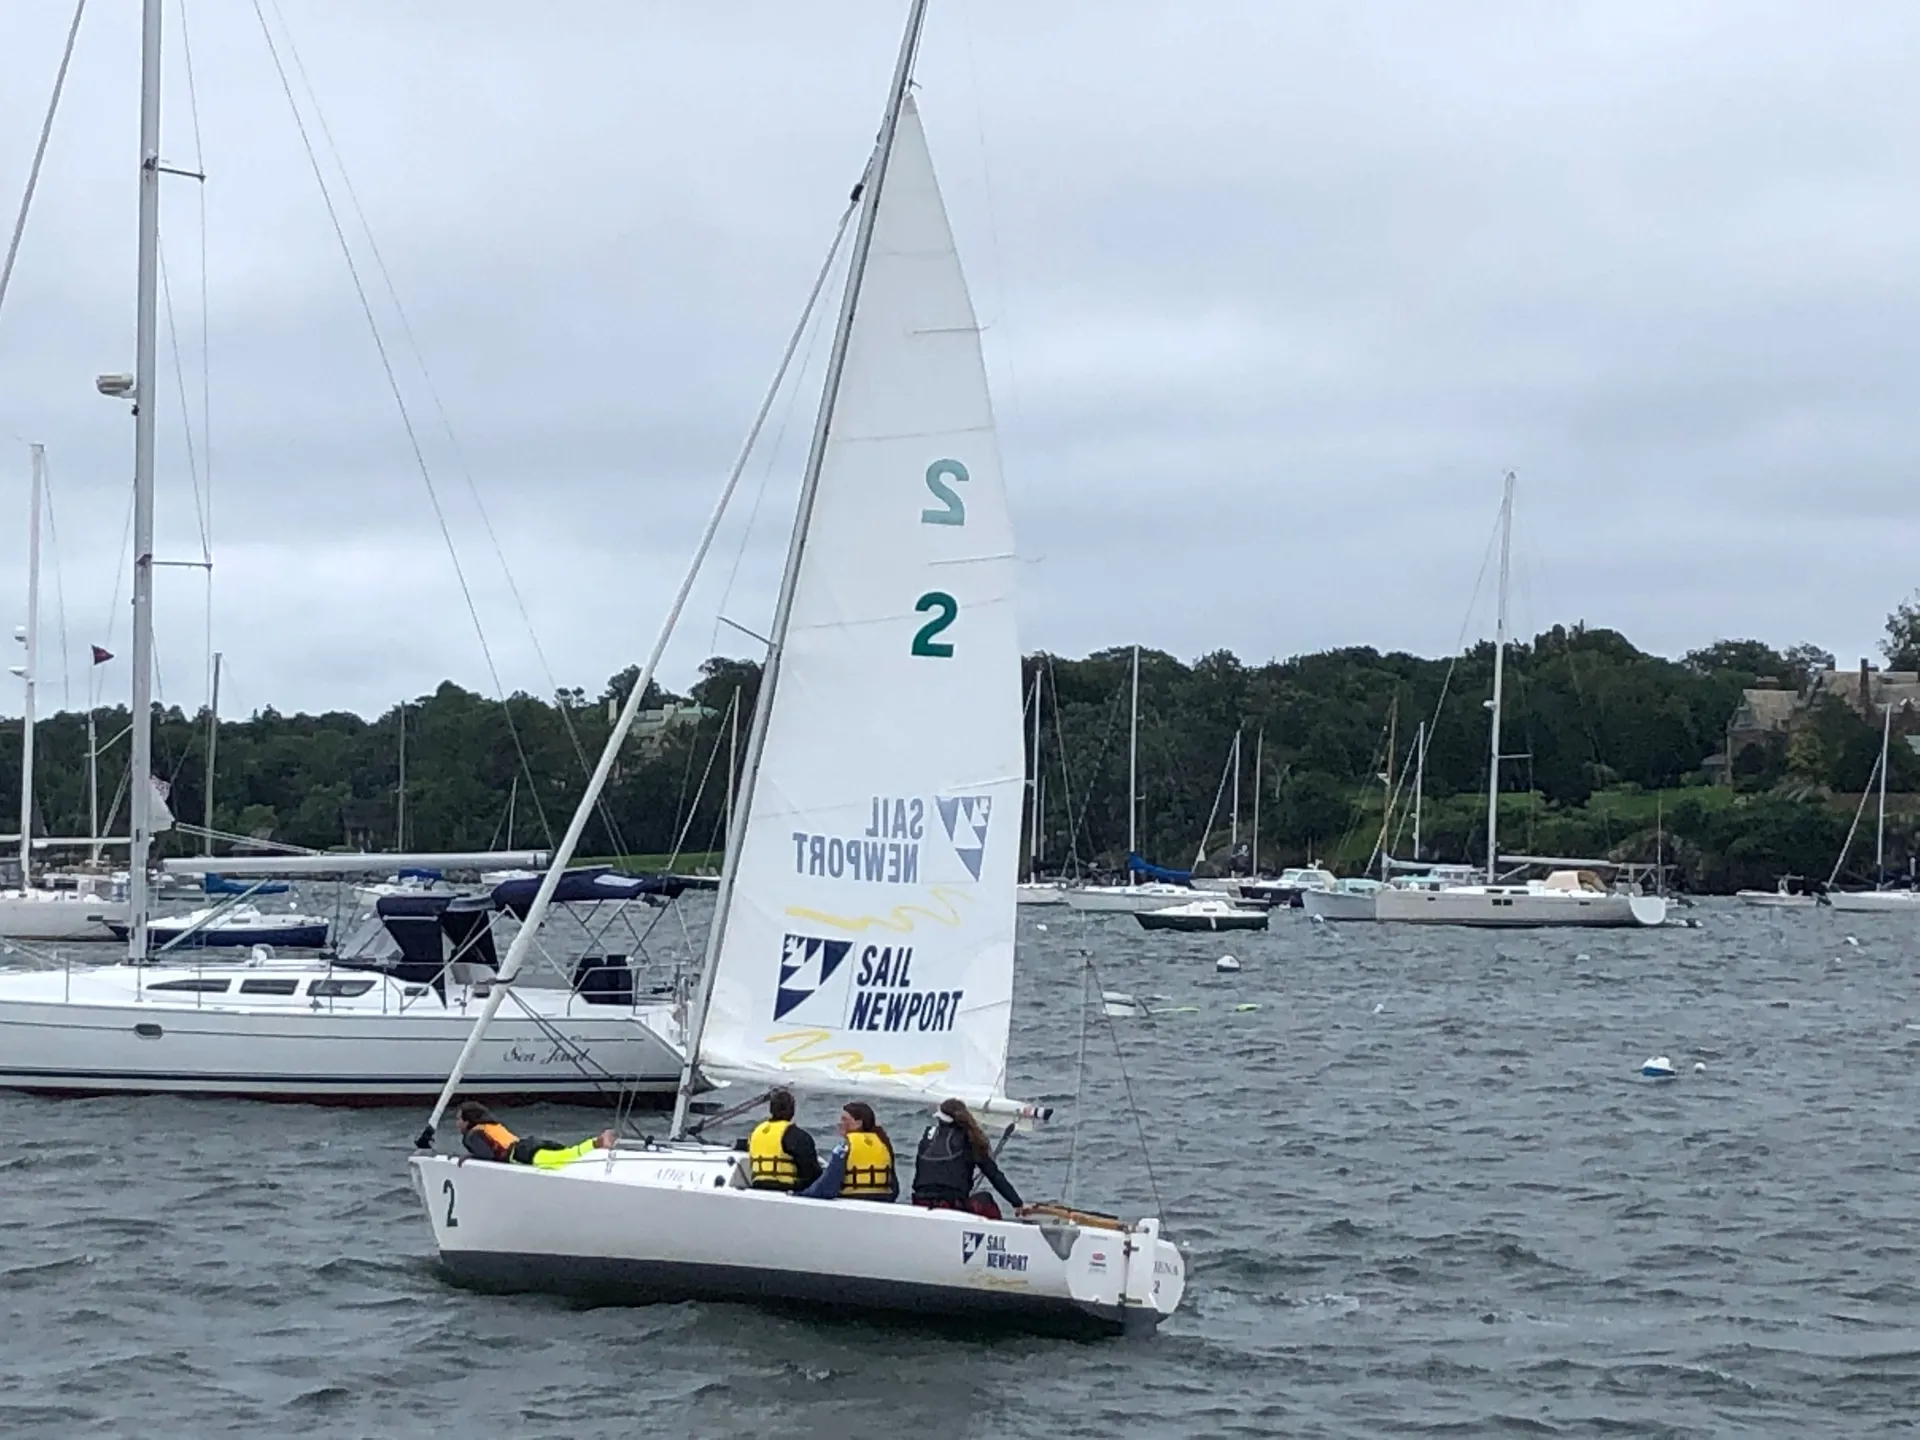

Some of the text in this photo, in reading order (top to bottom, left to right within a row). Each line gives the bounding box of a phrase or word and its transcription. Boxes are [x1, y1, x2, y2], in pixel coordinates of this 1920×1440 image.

[911, 591, 958, 658] 2
[857, 945, 913, 987] SAIL
[848, 990, 964, 1032] NEWPORT
[443, 1178, 458, 1227] 2
[986, 1234, 1006, 1252] SAIL
[986, 1252, 1028, 1272] NEWPORT
